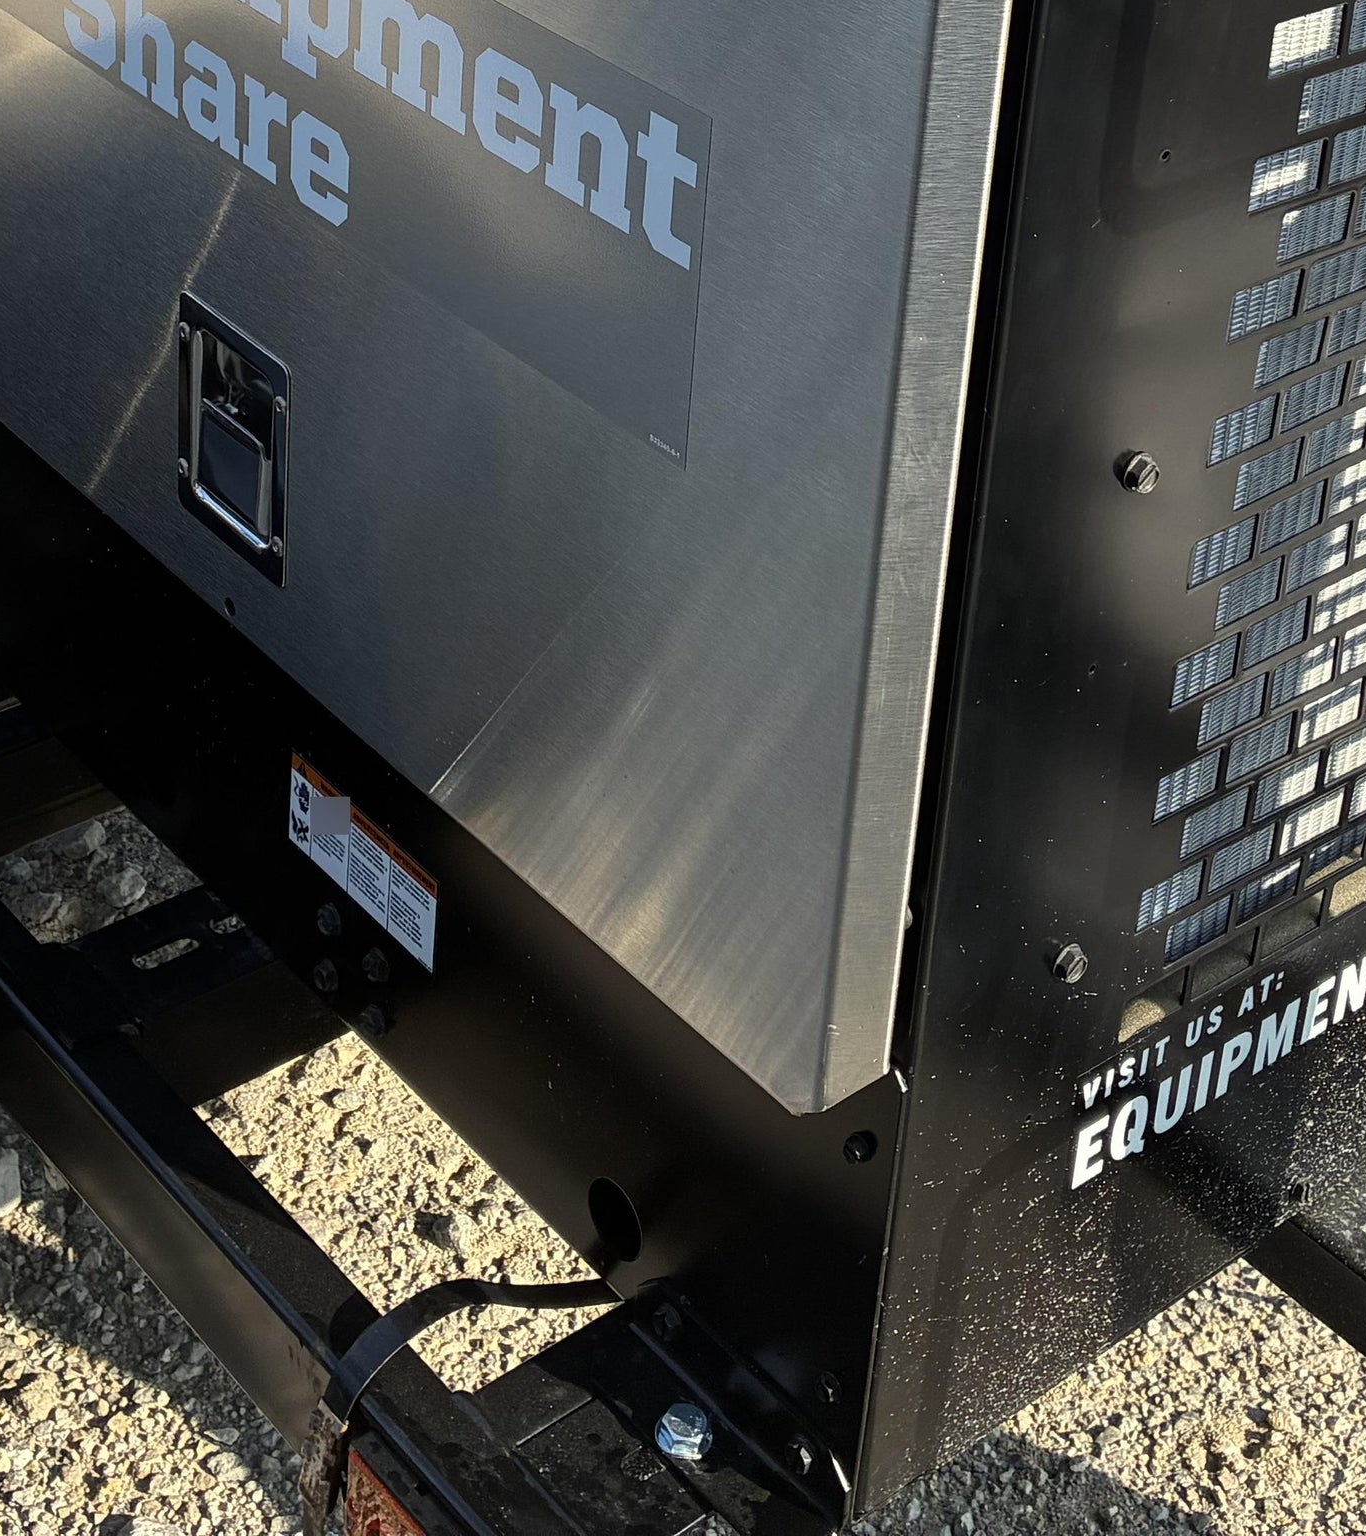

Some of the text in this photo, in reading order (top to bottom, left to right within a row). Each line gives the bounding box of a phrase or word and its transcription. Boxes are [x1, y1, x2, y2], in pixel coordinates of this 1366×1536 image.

[1083, 971, 1285, 1110] VISIT US AT:
